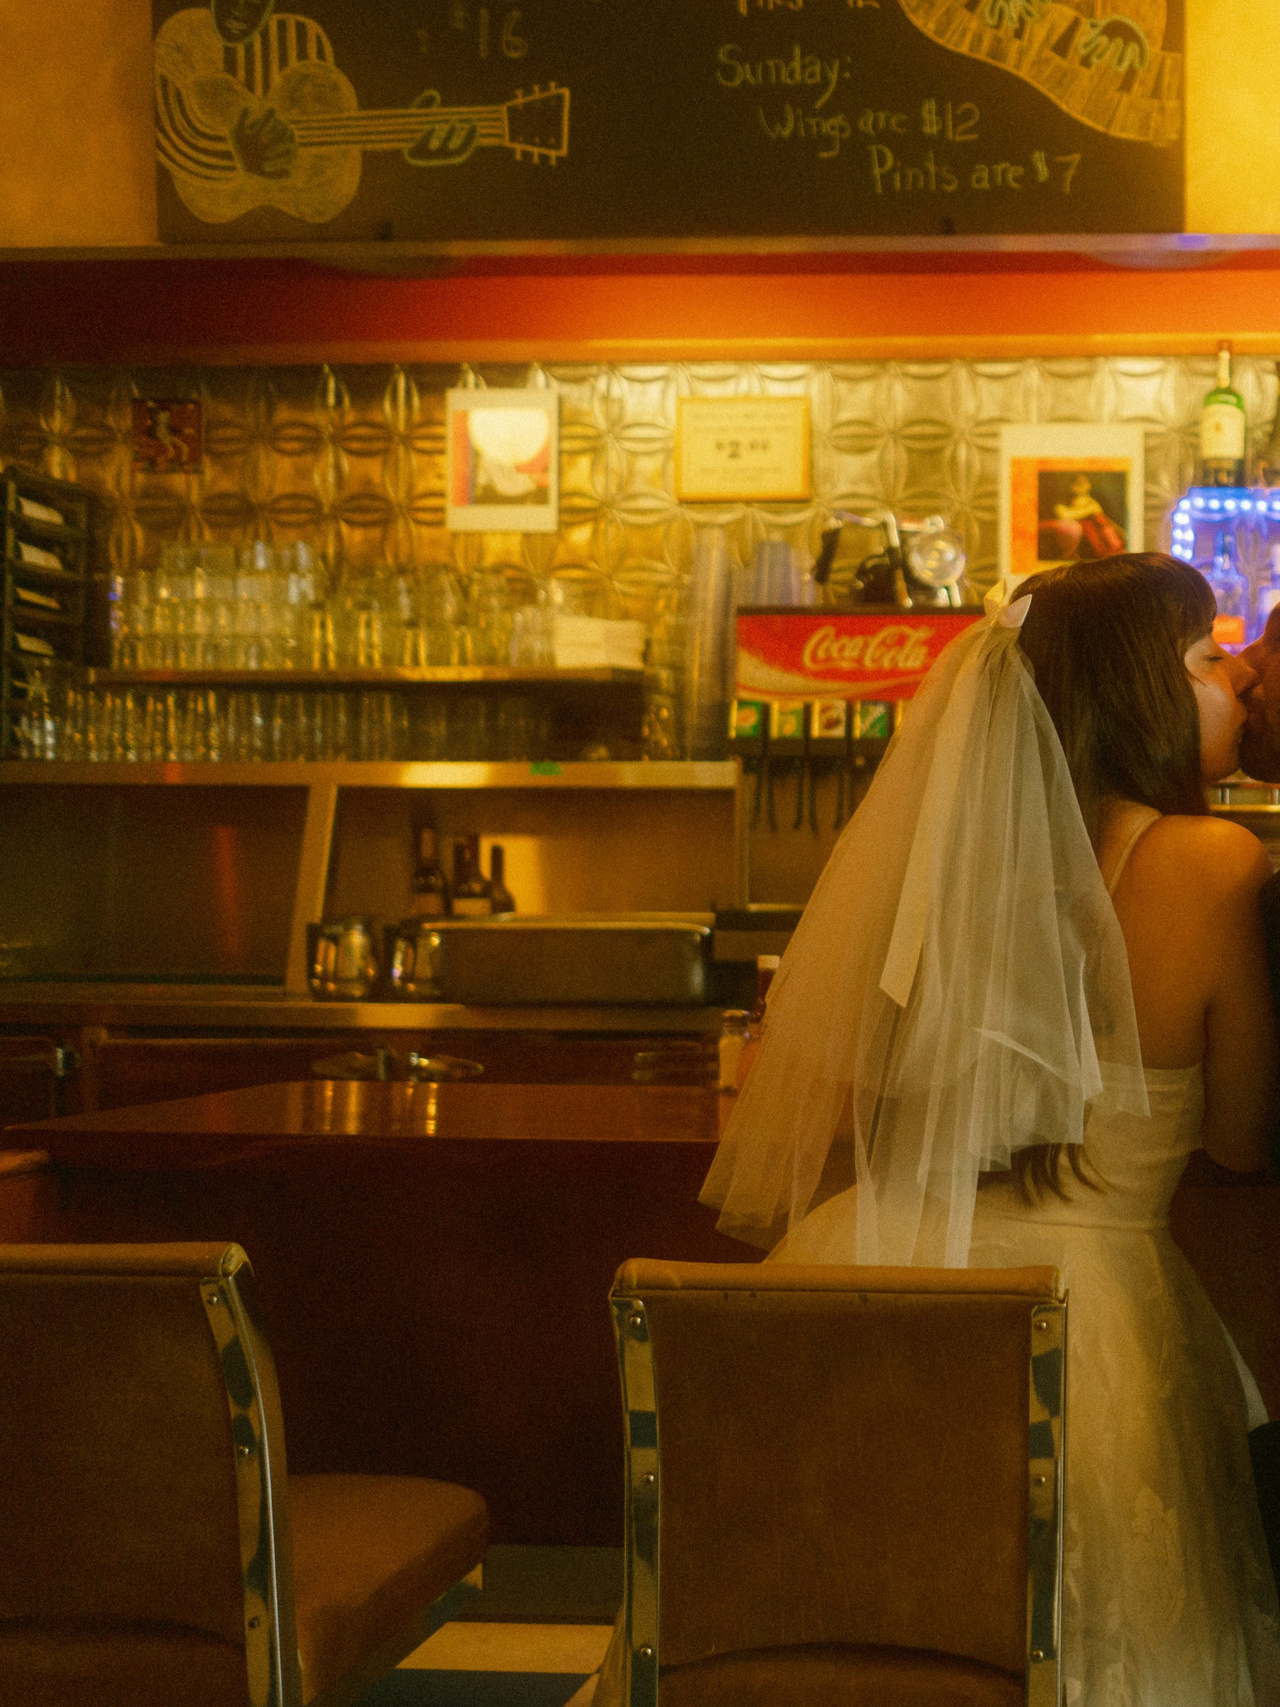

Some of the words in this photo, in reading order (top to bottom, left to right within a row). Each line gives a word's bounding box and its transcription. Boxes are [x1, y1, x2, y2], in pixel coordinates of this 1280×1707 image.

[716, 44, 851, 110] Sunday:
[759, 103, 850, 158] Wings
[857, 108, 907, 136] are
[921, 98, 980, 142] $12
[868, 143, 958, 194] Pints
[971, 161, 1025, 190] are
